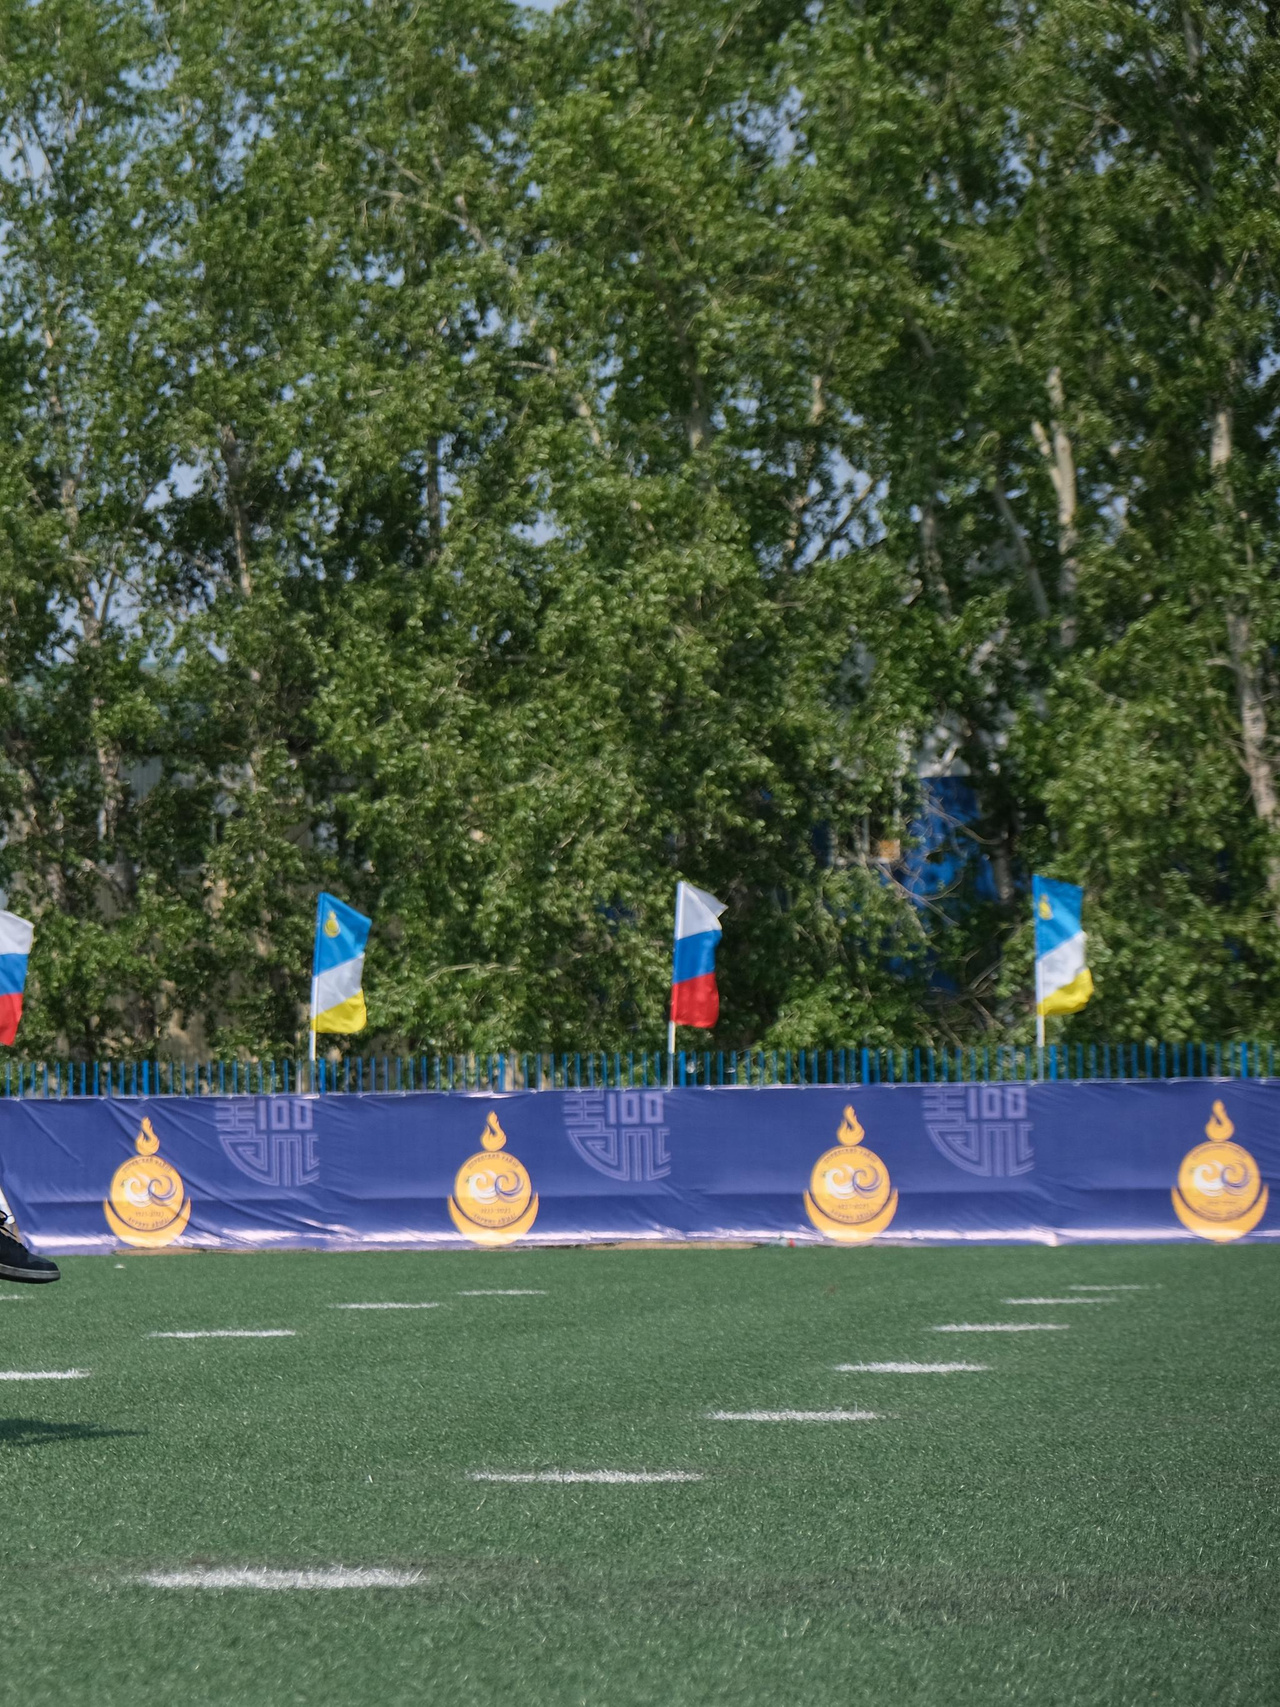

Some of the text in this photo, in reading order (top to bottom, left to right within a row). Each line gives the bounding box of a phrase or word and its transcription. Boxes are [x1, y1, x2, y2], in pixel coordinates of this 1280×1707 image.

[259, 1100, 314, 1131] 100
[608, 1092, 665, 1125] 100
[968, 1086, 1028, 1120] 100
